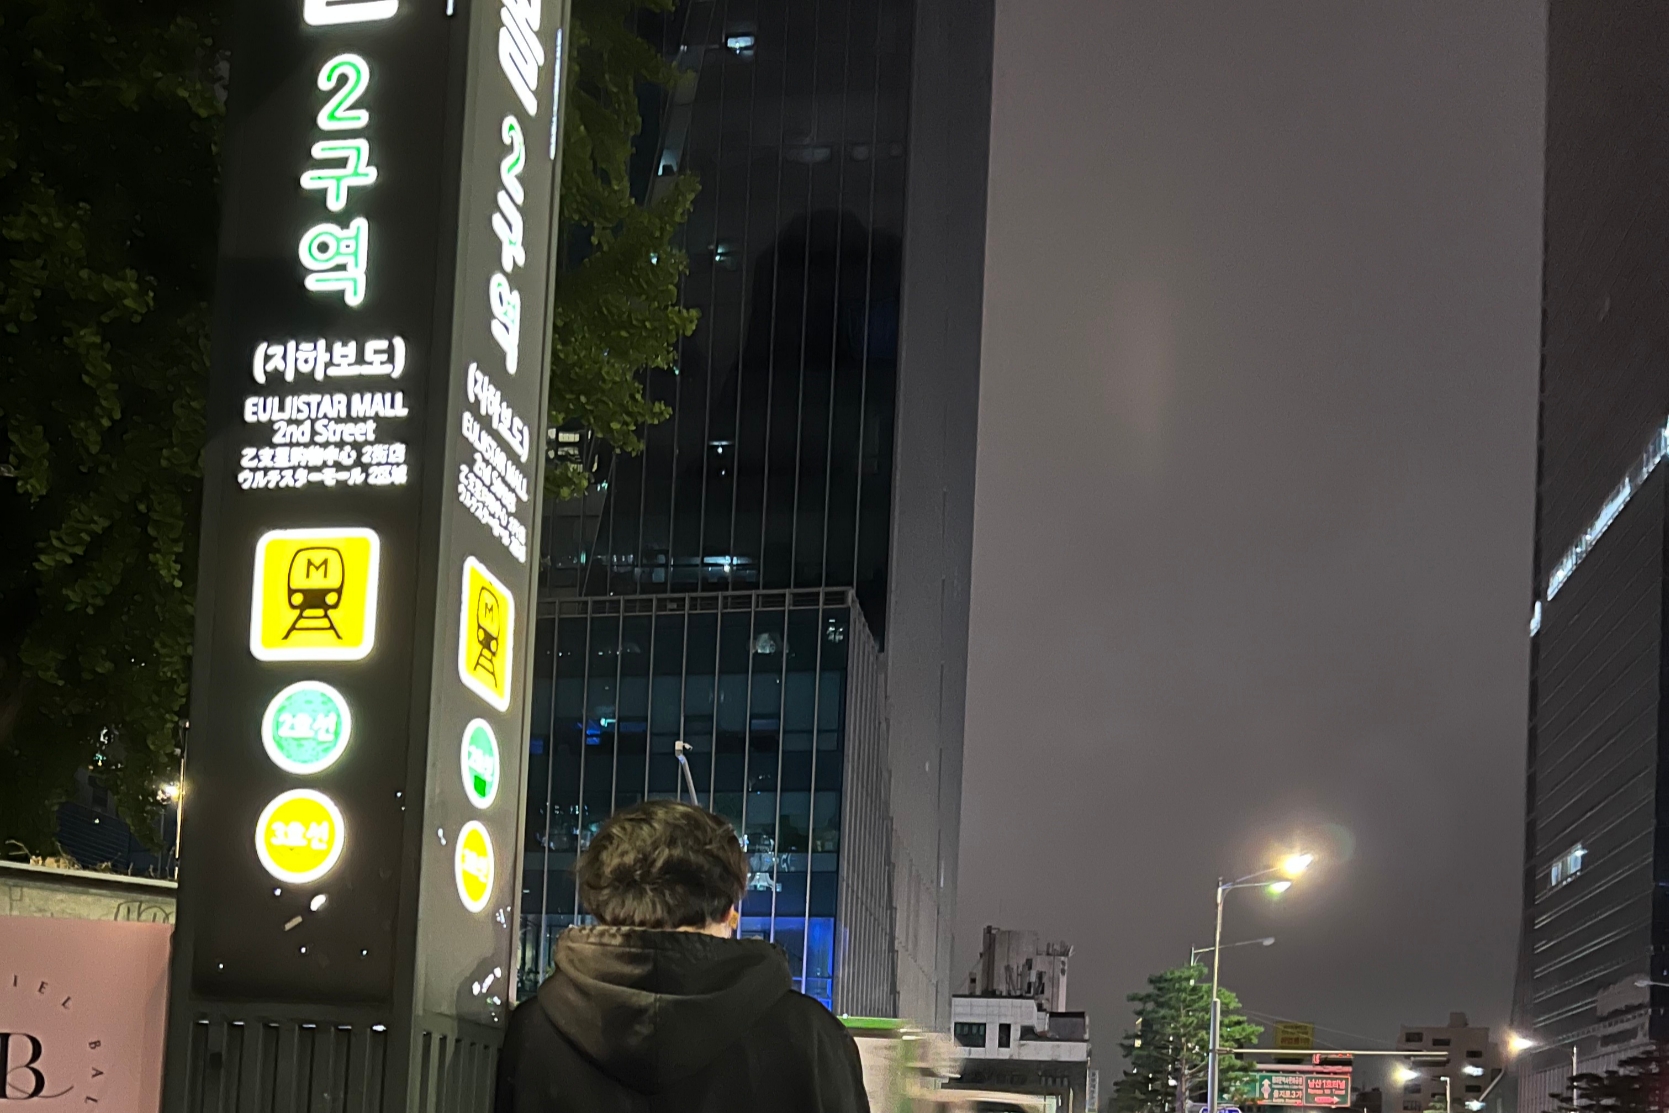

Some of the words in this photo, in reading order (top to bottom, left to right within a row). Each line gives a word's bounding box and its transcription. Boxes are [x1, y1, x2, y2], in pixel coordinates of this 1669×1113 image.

[253, 336, 406, 384] (지하보도)
[244, 393, 347, 422] EULJISTAR
[351, 391, 409, 418] MALL
[272, 420, 311, 444] 2nd
[314, 419, 376, 443] Street
